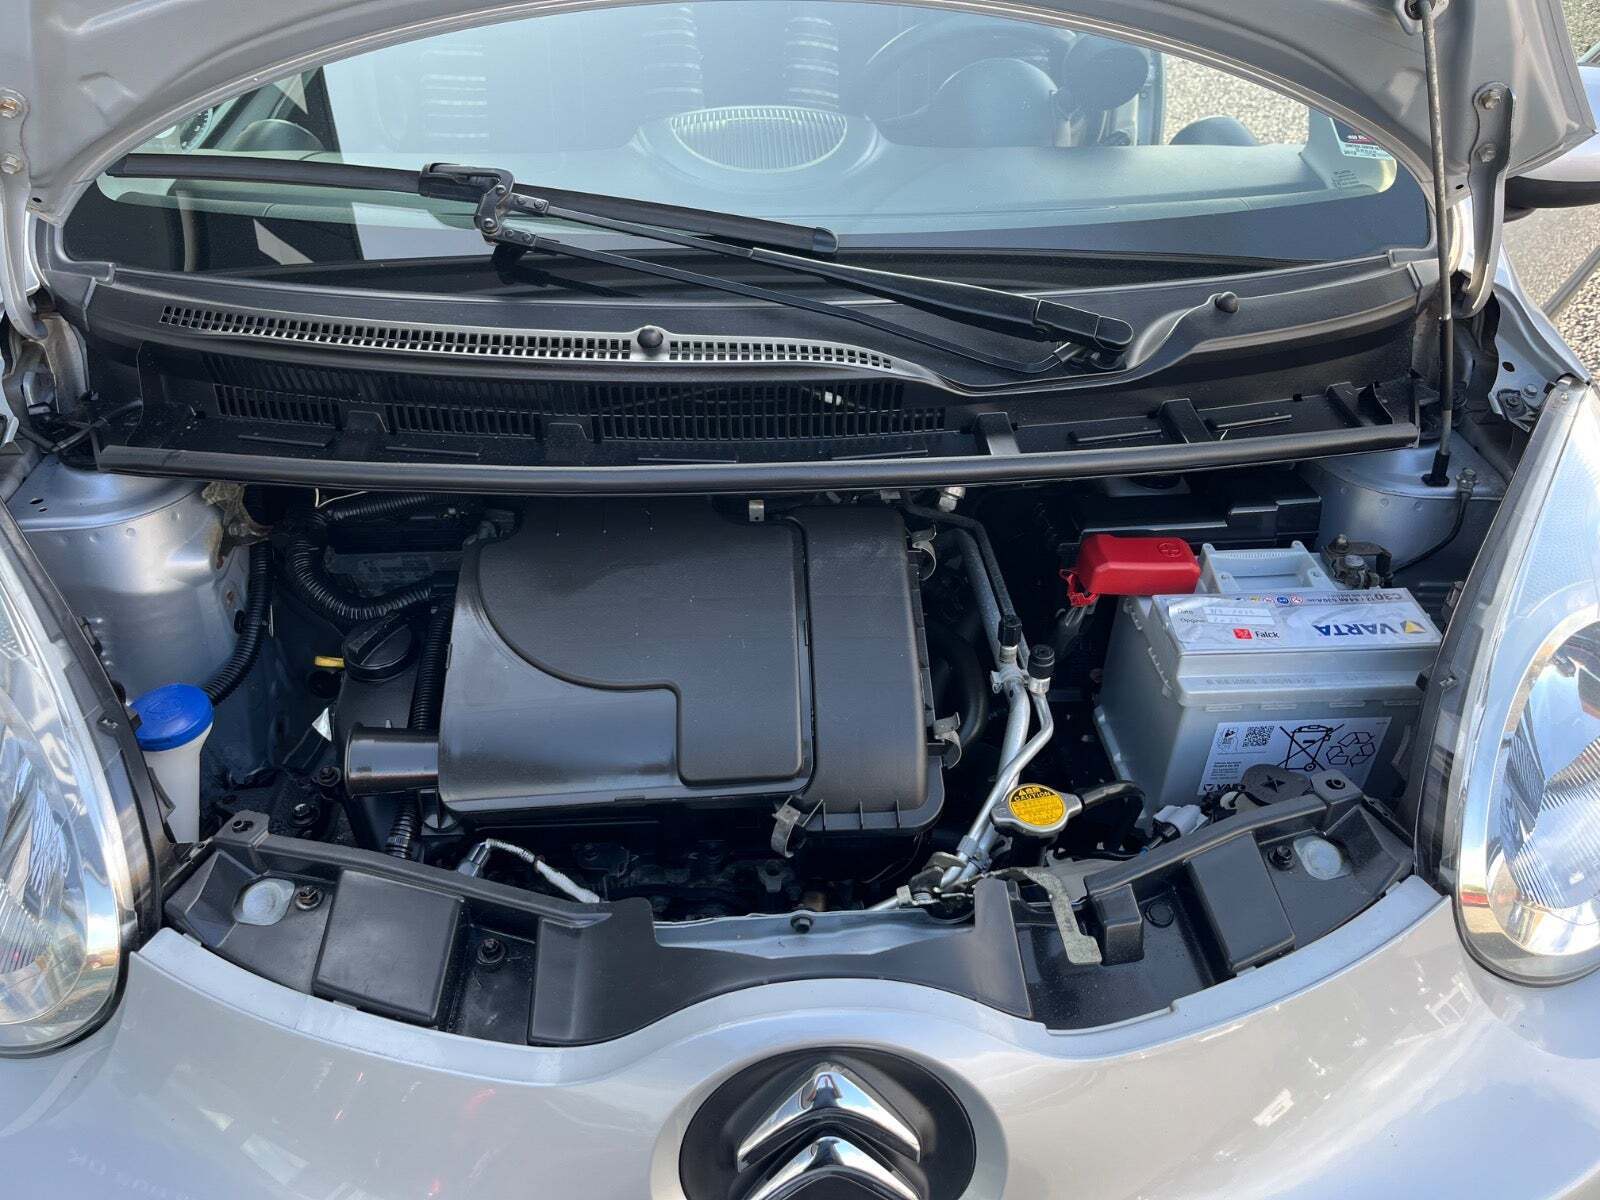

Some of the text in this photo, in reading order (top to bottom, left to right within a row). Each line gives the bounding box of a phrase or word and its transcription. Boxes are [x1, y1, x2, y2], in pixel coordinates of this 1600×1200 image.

[1255, 630, 1280, 639] Falck
[1313, 622, 1399, 637] VARTA
[1014, 791, 1051, 801] CAUTION
